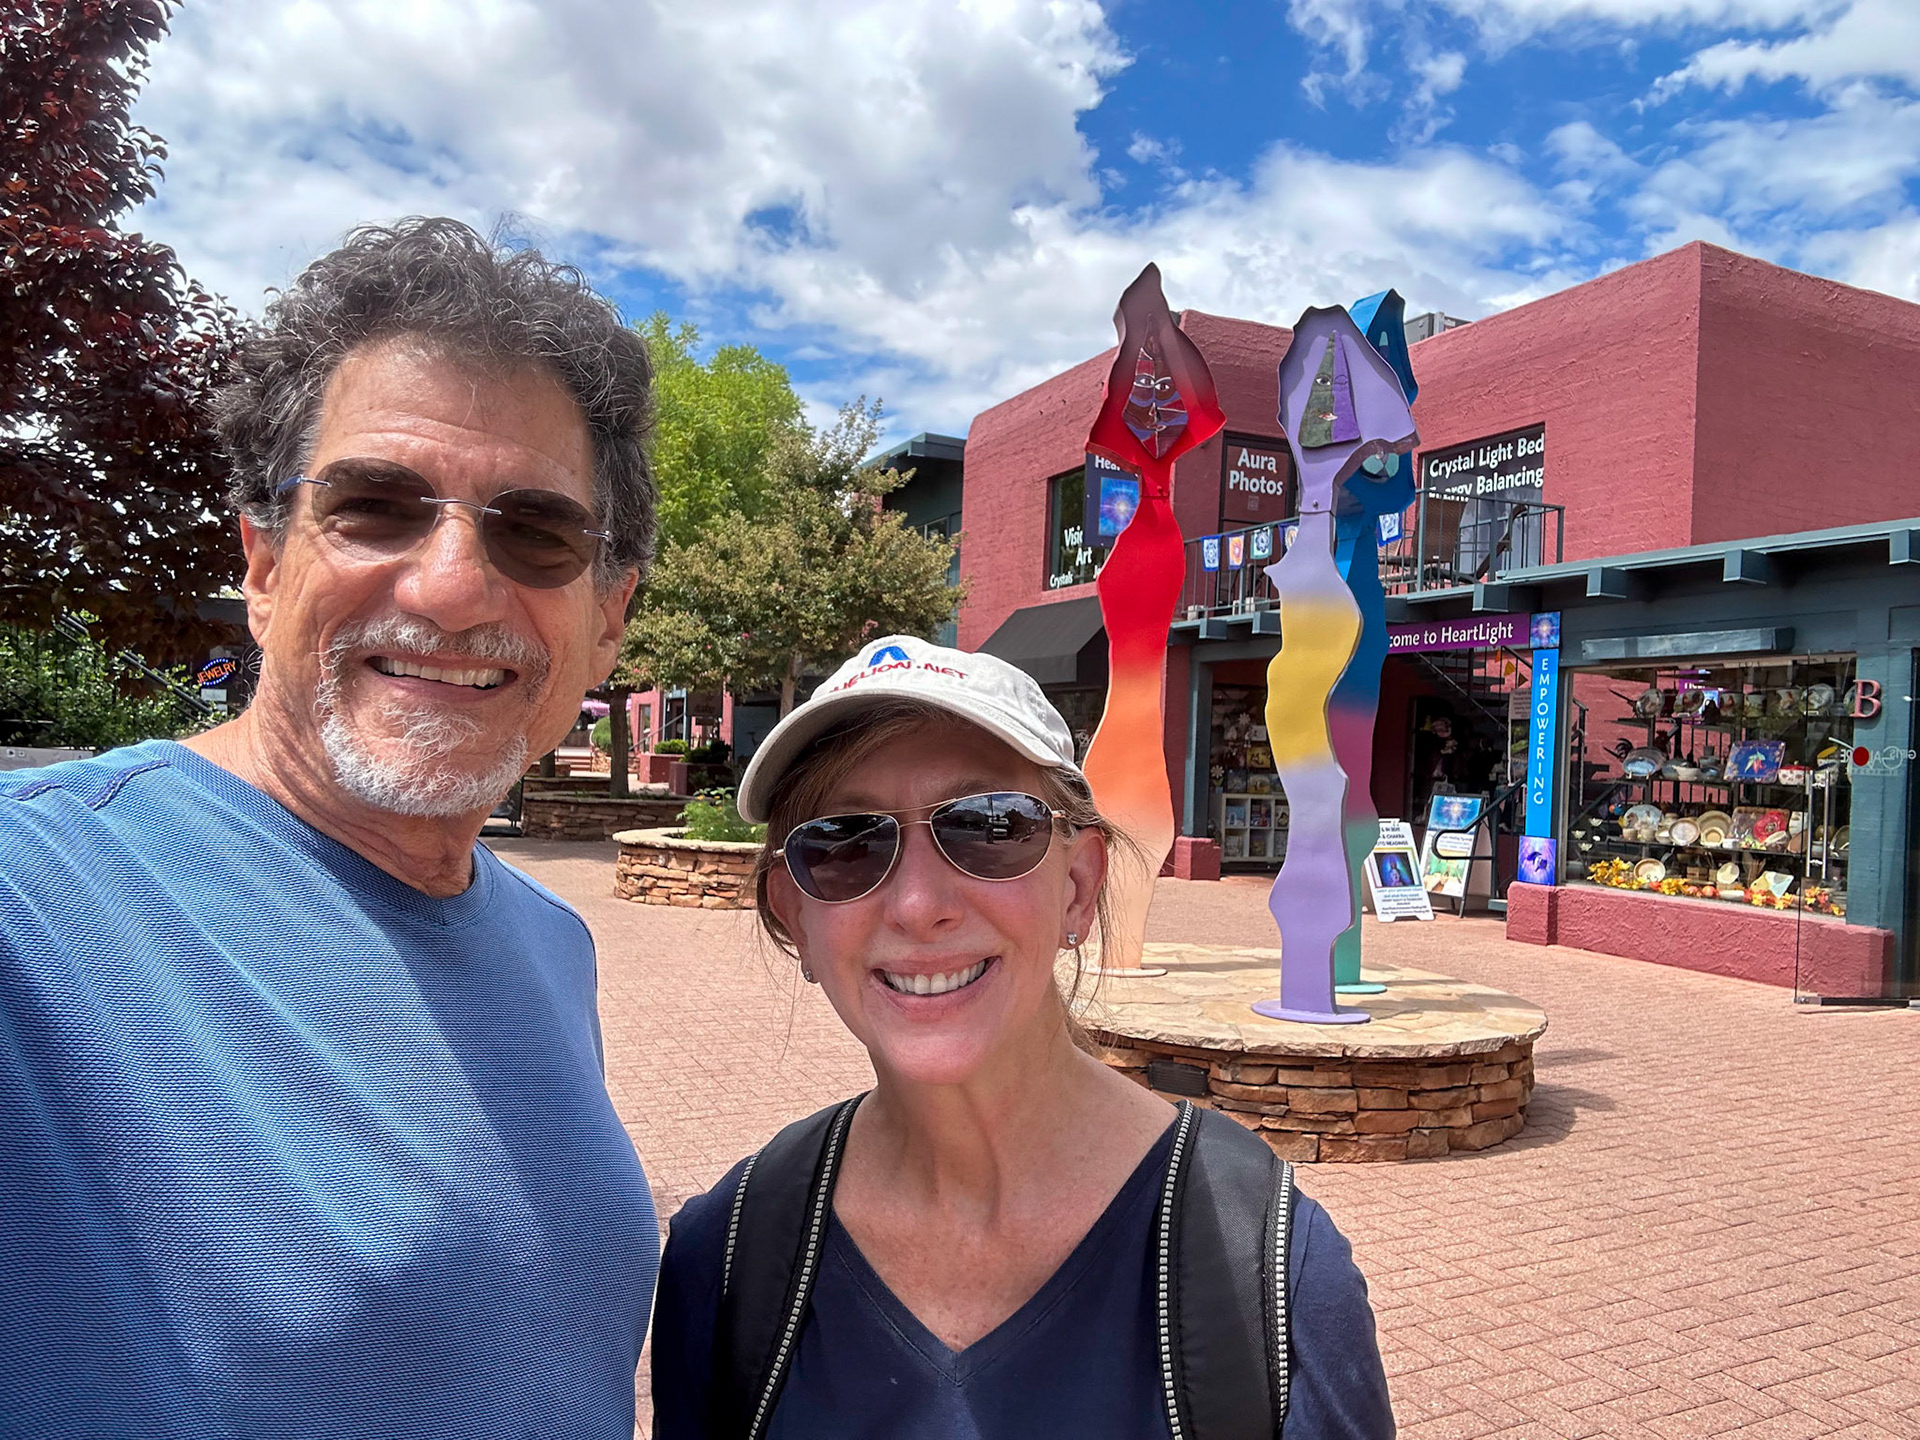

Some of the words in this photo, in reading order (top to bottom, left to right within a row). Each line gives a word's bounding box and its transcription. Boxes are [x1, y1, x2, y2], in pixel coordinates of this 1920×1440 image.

[1238, 448, 1277, 471] Aura
[1429, 450, 1474, 479] Crystal
[1479, 443, 1513, 469] Light
[1517, 433, 1544, 458] Bed
[1229, 470, 1283, 495] Photos
[1476, 465, 1544, 495] Balancing
[1075, 546, 1092, 567] Art
[1049, 570, 1073, 589] Crystals
[1423, 630, 1437, 645] to
[1441, 621, 1513, 645] HeartLight
[197, 660, 236, 685] JEWELRY
[1850, 679, 1882, 719] B
[1533, 658, 1550, 805] EMPOWERING
